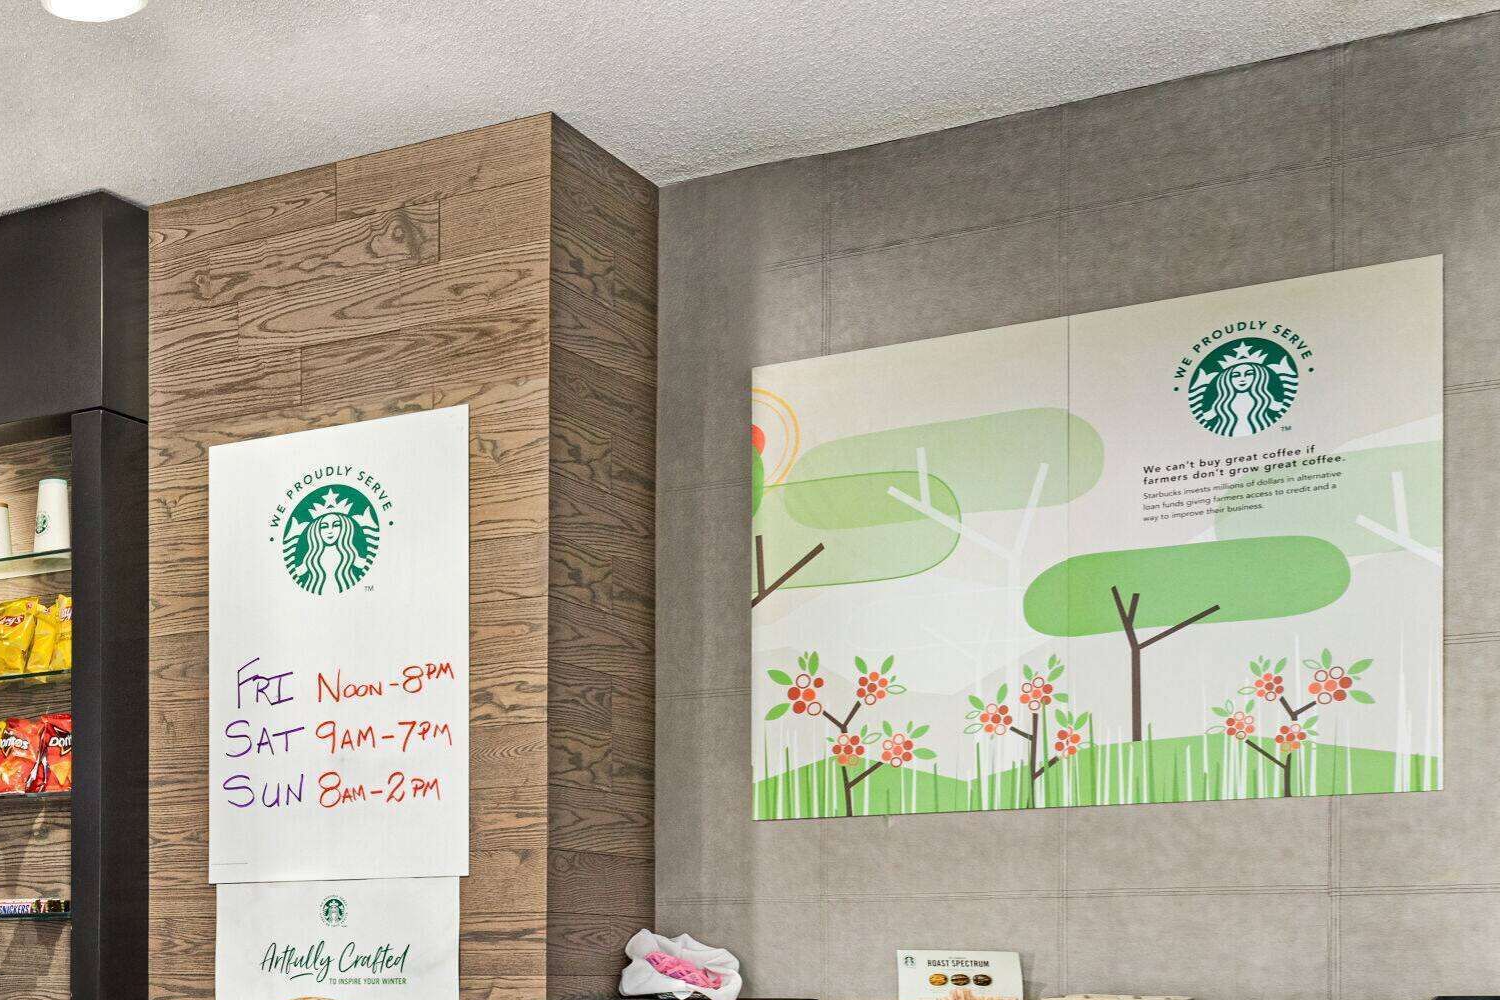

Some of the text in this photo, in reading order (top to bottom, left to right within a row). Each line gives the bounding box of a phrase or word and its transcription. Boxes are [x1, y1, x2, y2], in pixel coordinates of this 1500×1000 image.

[1175, 320, 1313, 379] WE PROUDLY SERVE
[1143, 445, 1316, 475] We can't buy great coffee if
[1143, 454, 1347, 485] farmers don't grow great coffee.
[270, 465, 393, 527] WE PROUDLY SERVE
[1143, 488, 1182, 500] Starbucks
[1183, 486, 1211, 495] invests
[1213, 482, 1244, 491] millions
[1246, 480, 1255, 488] of
[1257, 477, 1285, 486] dollars
[1297, 471, 1342, 482] alternative
[1143, 502, 1160, 511] loan
[1162, 500, 1184, 509] funds
[1186, 497, 1211, 508] giving
[1213, 493, 1245, 503] farmers
[1246, 491, 1273, 499] access
[1286, 485, 1311, 494] credit
[1312, 483, 1330, 492] and
[1160, 511, 1169, 520] to
[1171, 508, 1204, 520] improve
[1206, 504, 1225, 515] their
[237, 657, 294, 709] FRI
[225, 719, 305, 758] SAT
[223, 773, 304, 808] SUN
[260, 940, 411, 983] Artfully Crafted
[927, 959, 949, 967] ROAST
